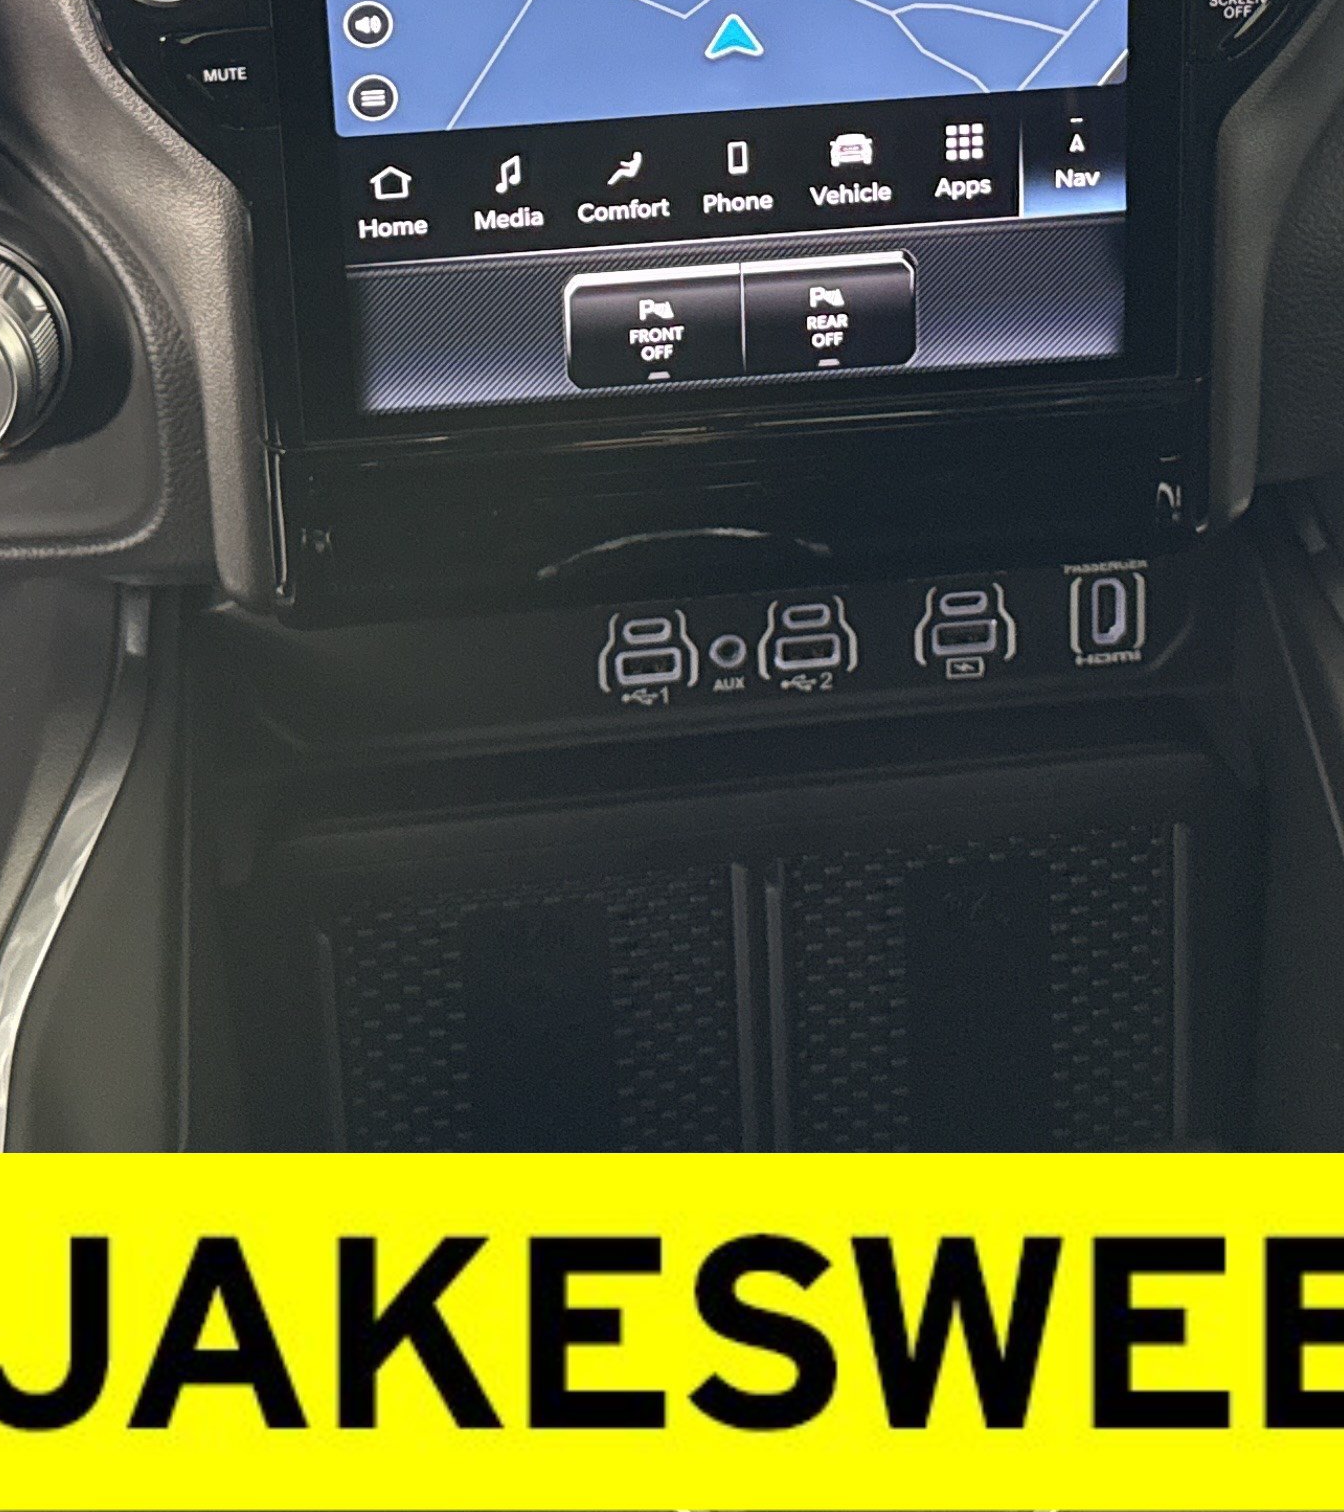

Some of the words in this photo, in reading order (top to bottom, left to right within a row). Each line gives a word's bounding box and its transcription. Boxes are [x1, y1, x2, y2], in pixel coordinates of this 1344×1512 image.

[1223, 4, 1253, 19] OFF
[203, 67, 247, 82] MUTE
[935, 175, 992, 200] Apps
[1055, 168, 1100, 189] Nav
[703, 191, 773, 214] Phone
[809, 182, 892, 206] Vehicle
[474, 206, 544, 230] Media
[577, 197, 670, 223] Comfort
[359, 217, 429, 239] Home
[806, 313, 849, 331] REAR
[629, 326, 684, 345] FRONT
[811, 331, 844, 348] OFF
[640, 344, 674, 362] OFF
[713, 677, 745, 692] AUX
[820, 672, 833, 690] 2
[659, 686, 669, 704] 1
